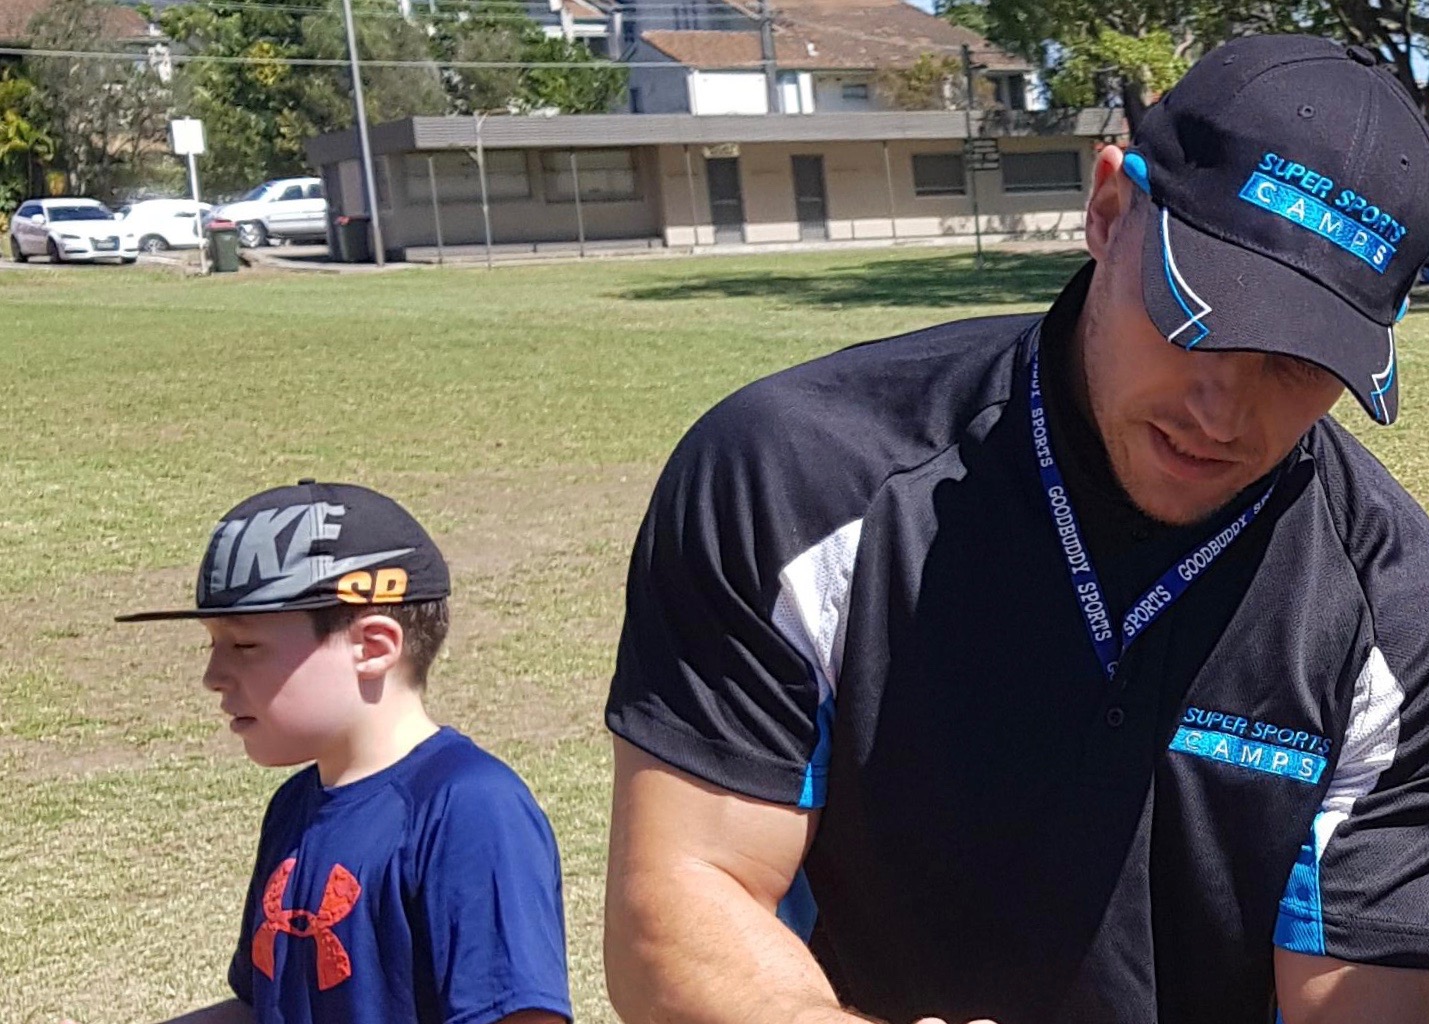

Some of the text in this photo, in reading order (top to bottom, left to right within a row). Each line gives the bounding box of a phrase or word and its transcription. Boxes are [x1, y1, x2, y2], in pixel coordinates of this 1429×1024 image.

[1256, 181, 1387, 265] CAMPS
[1258, 153, 1407, 243] SUPER SPORTS
[1031, 407, 1054, 468] SPORTS
[210, 502, 346, 594] IKE
[1048, 485, 1113, 642] GOODBUDDY SPORTS
[1123, 514, 1249, 637] SPORTS GOODBUDDY
[1183, 706, 1333, 755] SUPER SPORTS
[1185, 731, 1314, 777] CAMPS
